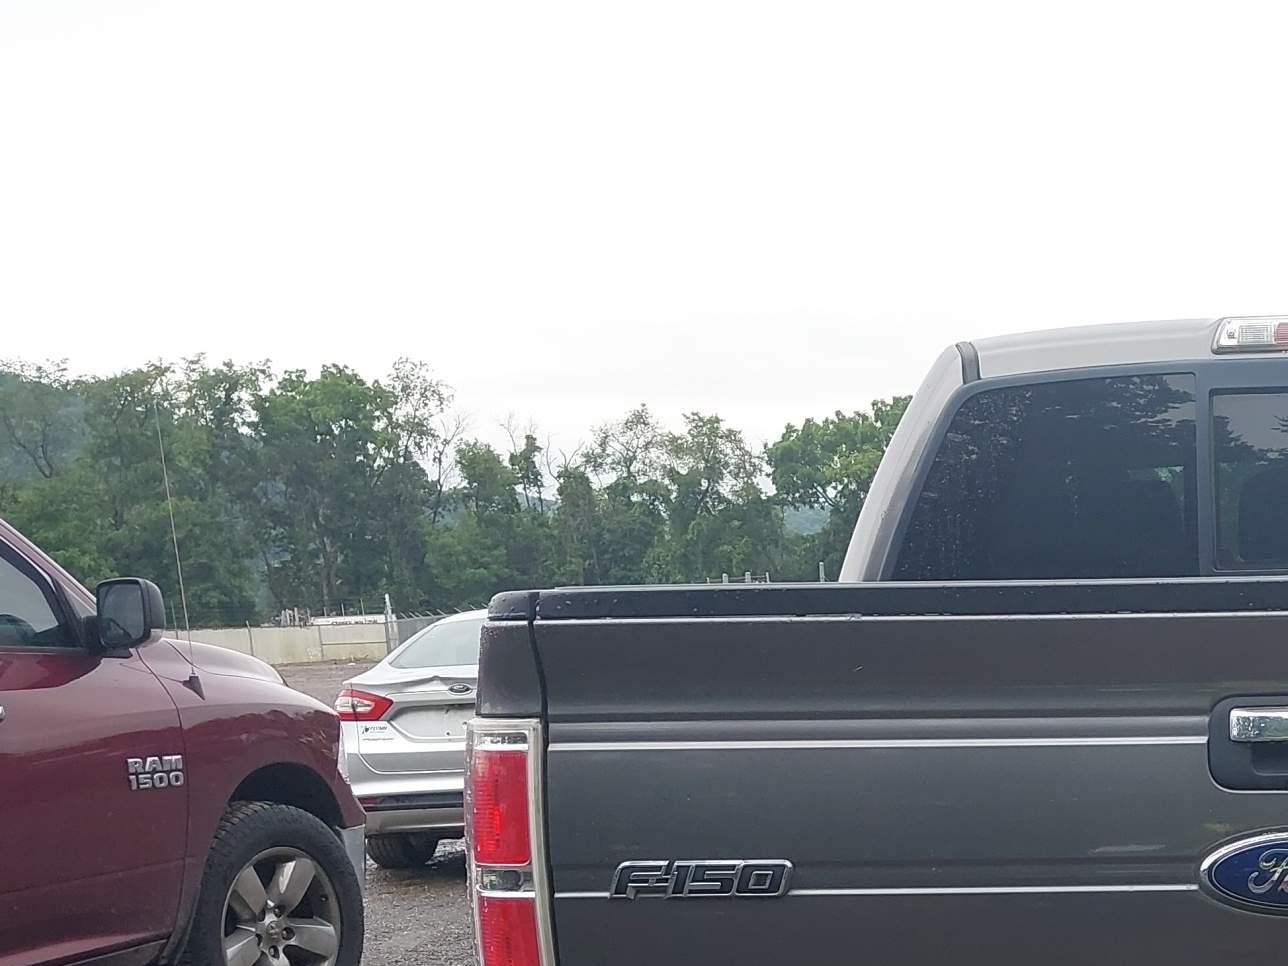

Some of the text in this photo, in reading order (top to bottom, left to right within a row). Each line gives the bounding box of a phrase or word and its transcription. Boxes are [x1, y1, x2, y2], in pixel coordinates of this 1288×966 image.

[127, 755, 183, 773] RAM
[128, 771, 184, 790] 1500
[608, 859, 793, 900] F-150
